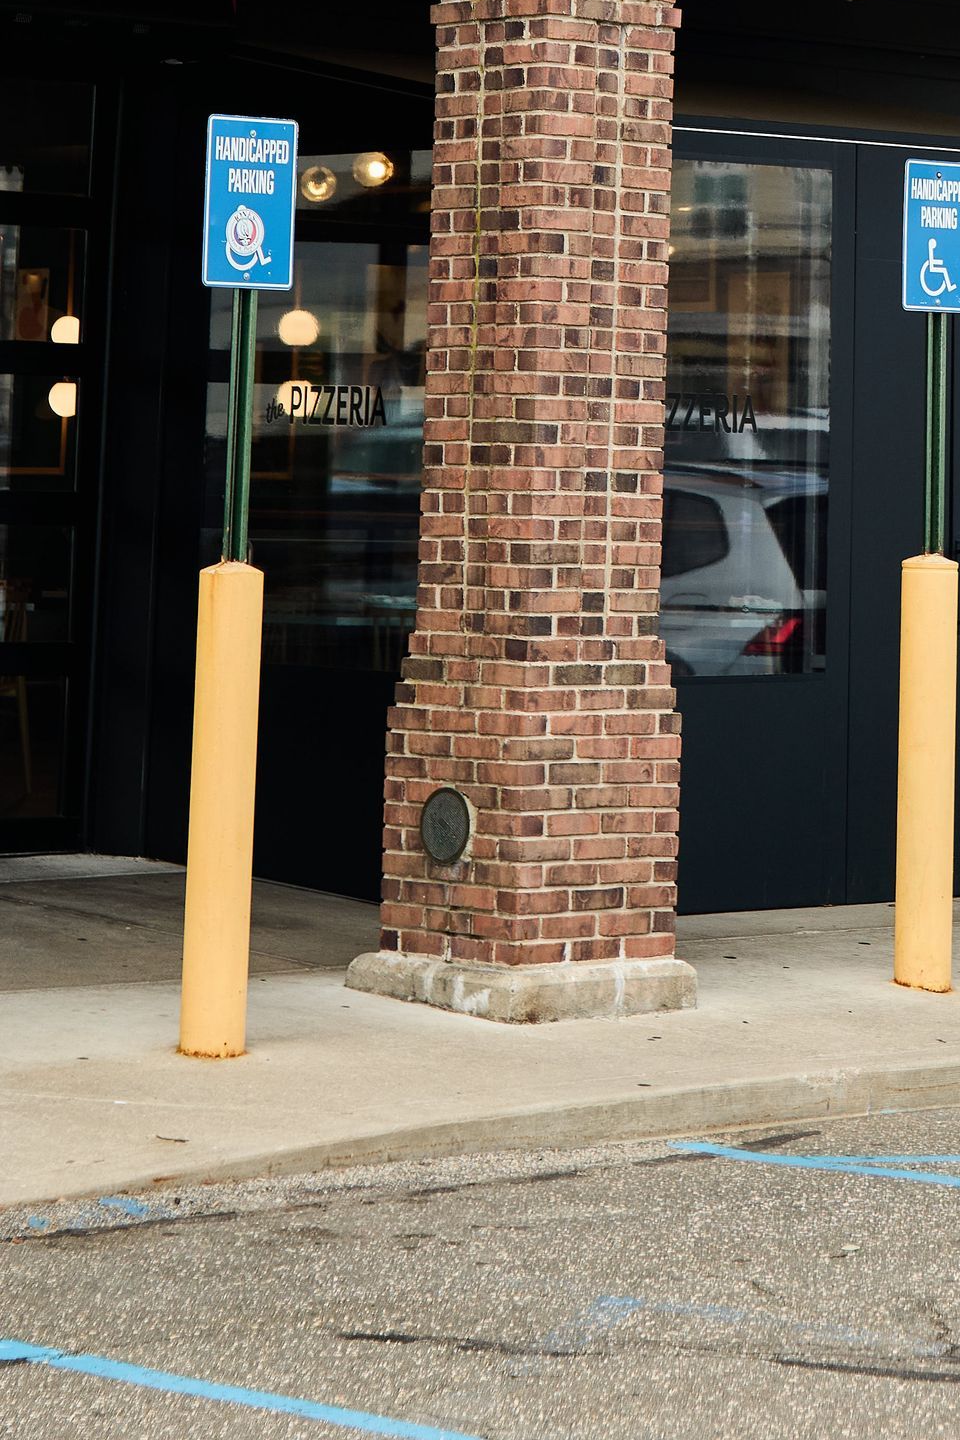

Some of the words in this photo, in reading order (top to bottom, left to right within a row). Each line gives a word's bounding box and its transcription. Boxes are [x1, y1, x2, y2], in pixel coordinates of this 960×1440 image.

[215, 136, 290, 164] HANDICAPPED
[228, 167, 275, 195] PARKING
[920, 206, 958, 230] PARKING
[265, 398, 286, 424] the
[289, 385, 387, 427] PIZZERIA
